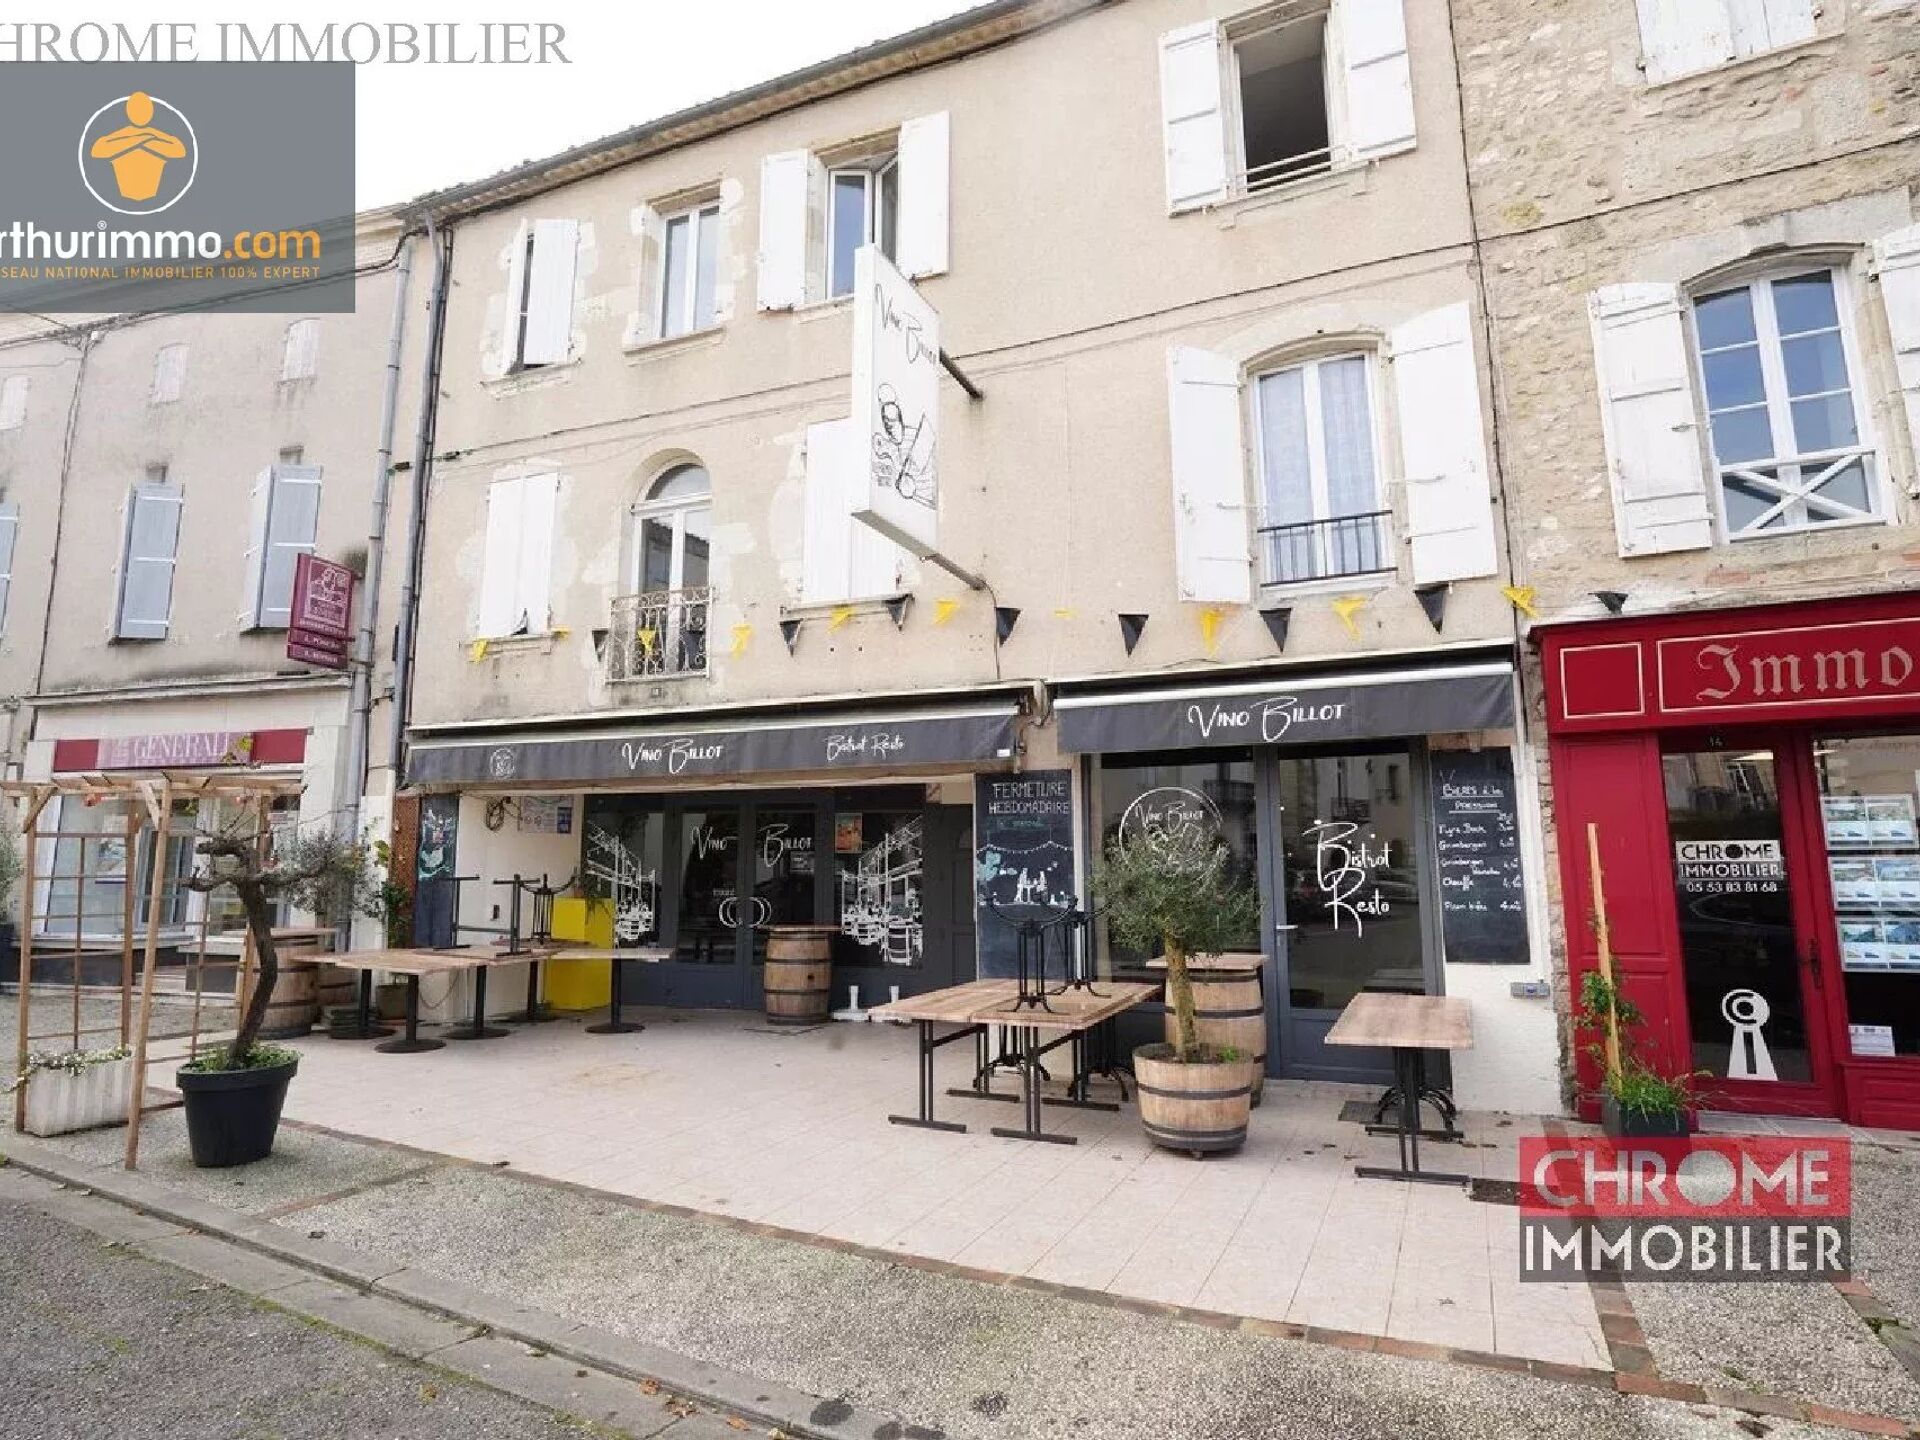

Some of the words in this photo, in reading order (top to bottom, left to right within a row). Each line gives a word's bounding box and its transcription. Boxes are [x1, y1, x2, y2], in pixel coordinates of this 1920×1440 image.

[992, 781, 1068, 799] FERMETURE
[988, 801, 1071, 815] HEBDOMADAIRE
[1302, 821, 1393, 892] Bistrot
[1681, 843, 1774, 861] CHROME
[1679, 864, 1780, 878] IMMOBILIER
[1323, 868, 1390, 938] Resto
